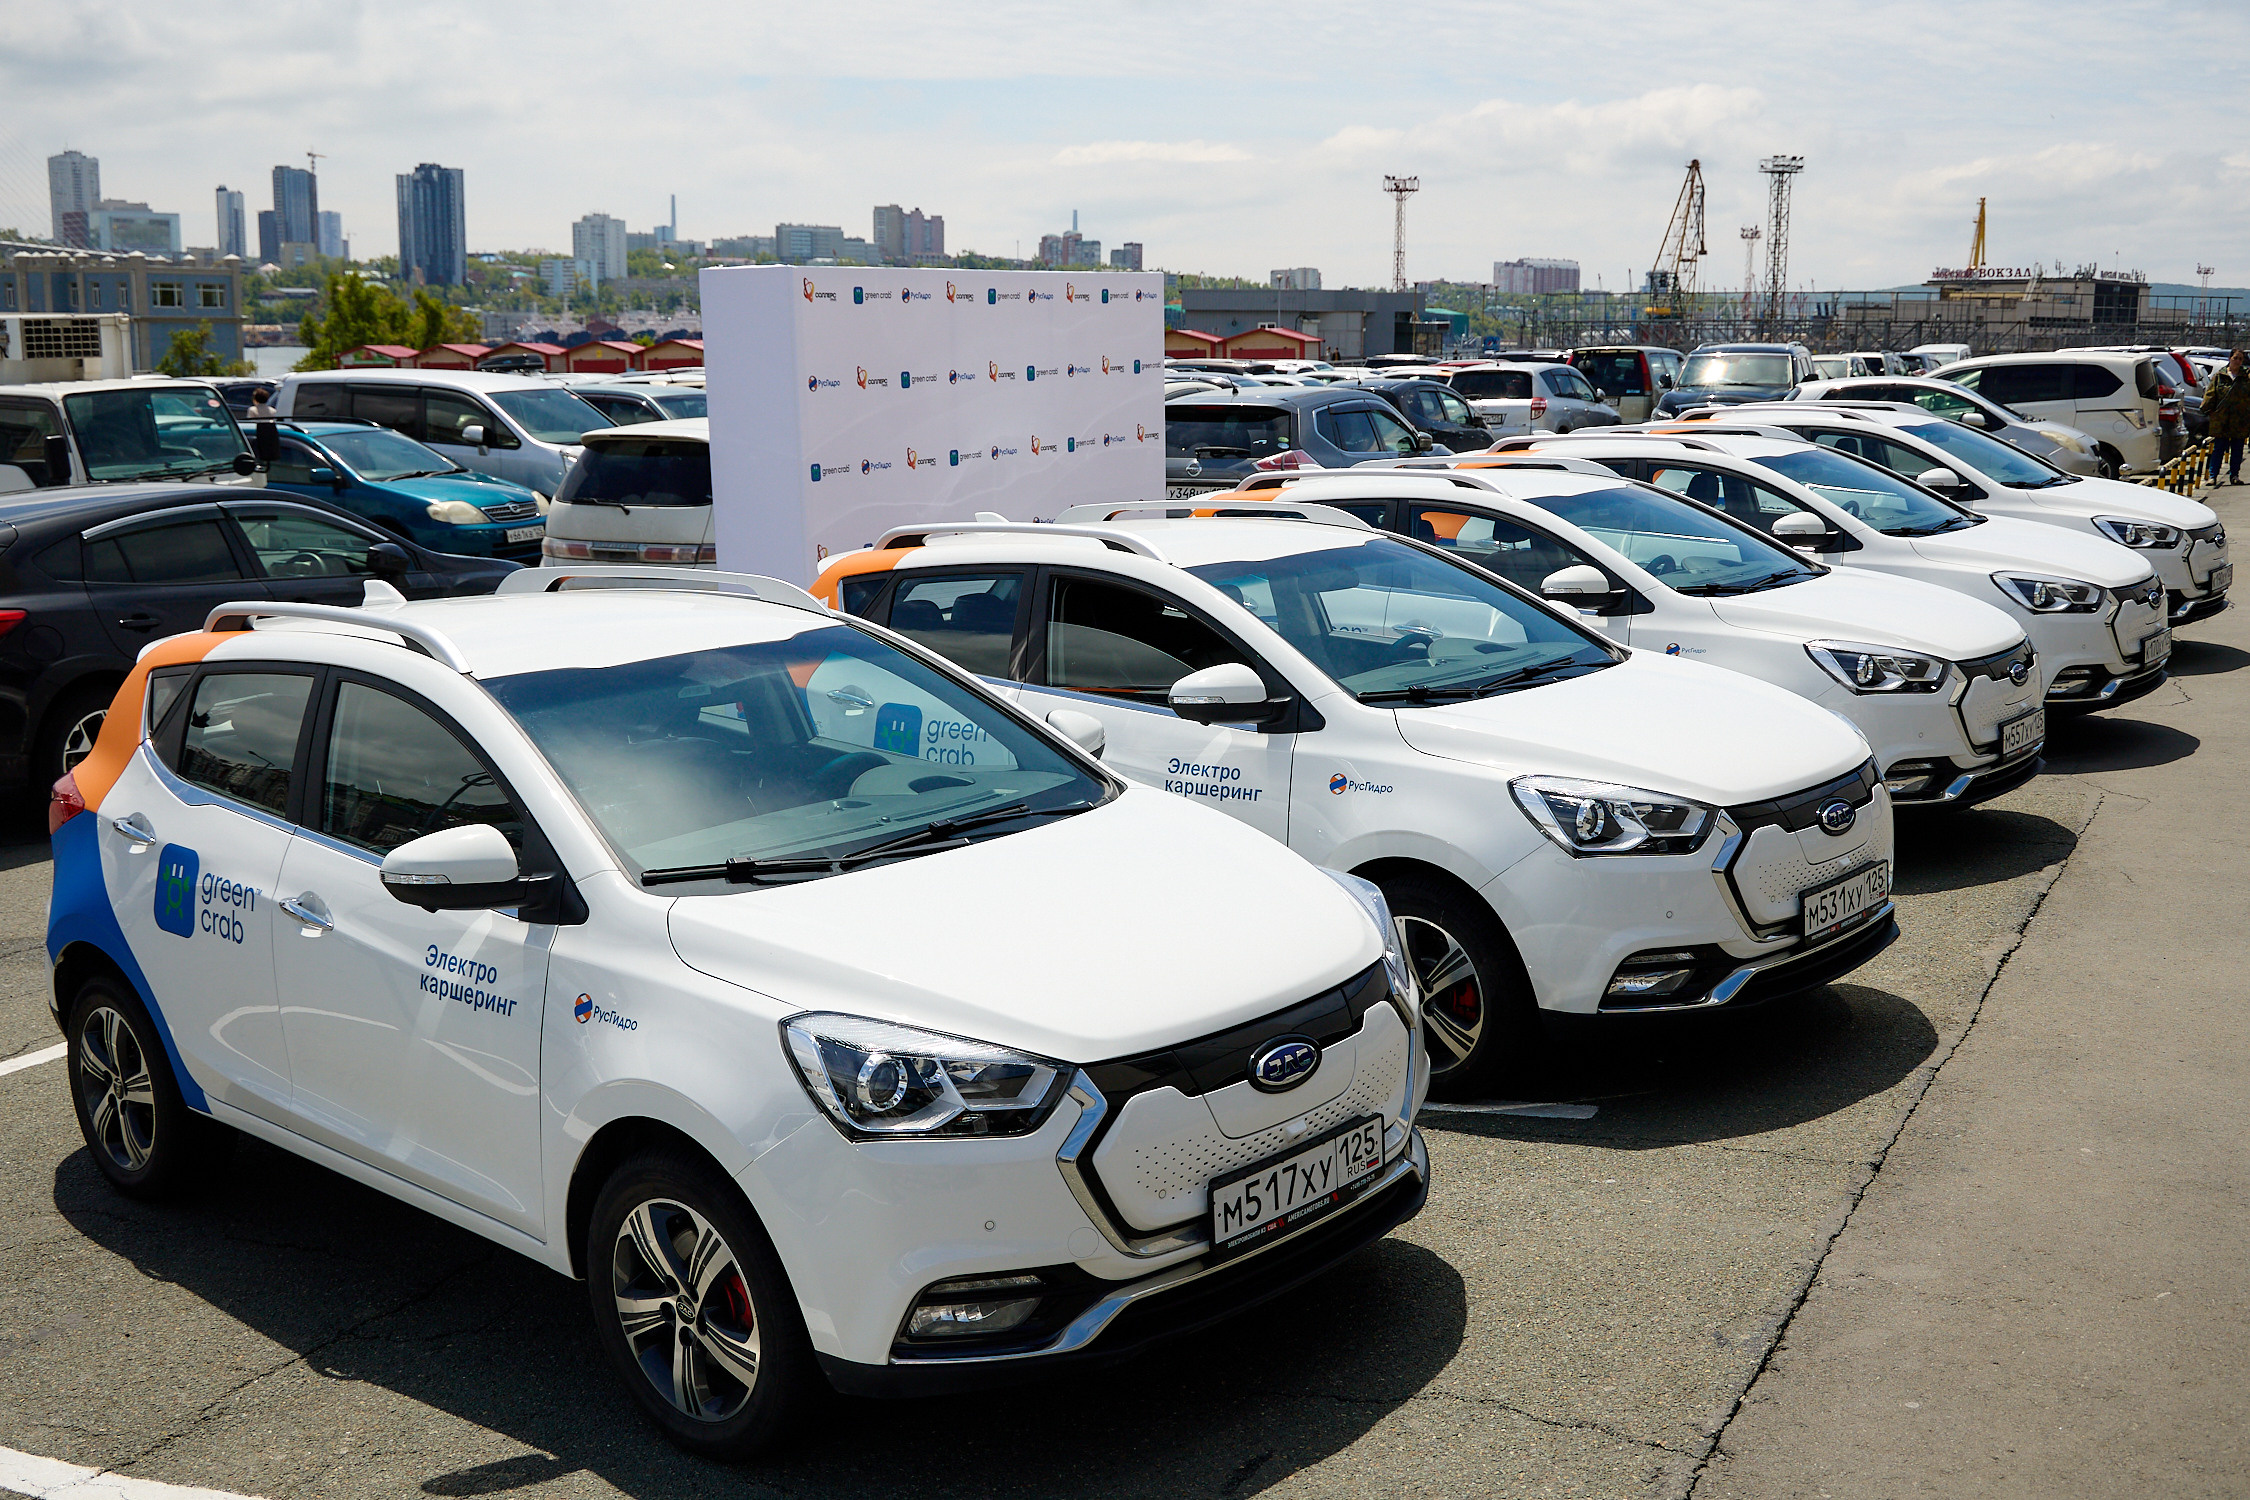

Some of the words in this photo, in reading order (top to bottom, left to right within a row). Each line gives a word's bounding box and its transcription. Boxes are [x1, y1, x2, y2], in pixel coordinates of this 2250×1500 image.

[1979, 268, 2032, 278] ВОКЗАЛ
[864, 292, 880, 301] green
[880, 291, 891, 299] crab
[997, 293, 1010, 301] green
[1010, 291, 1020, 299] crab
[911, 375, 926, 384] green
[926, 373, 936, 381] crab
[822, 466, 837, 477] green
[838, 464, 849, 474] crab
[926, 719, 987, 744] green
[926, 743, 975, 766] crab
[1167, 757, 1241, 783] Электро
[1164, 778, 1262, 802] каршеринг
[1348, 780, 1394, 794] РусГидро
[201, 872, 255, 912] green
[1809, 884, 1863, 930] М531ХУ
[1865, 867, 1884, 894] 125
[201, 908, 244, 945] crab
[425, 944, 498, 985] Электро
[419, 973, 518, 1017] каршеринг
[593, 1005, 638, 1031] РусГидро
[1268, 1047, 1312, 1079] JAC
[1222, 1155, 1333, 1234] М517ХУ
[1339, 1124, 1376, 1167] 125
[1347, 1161, 1366, 1179] RUS
